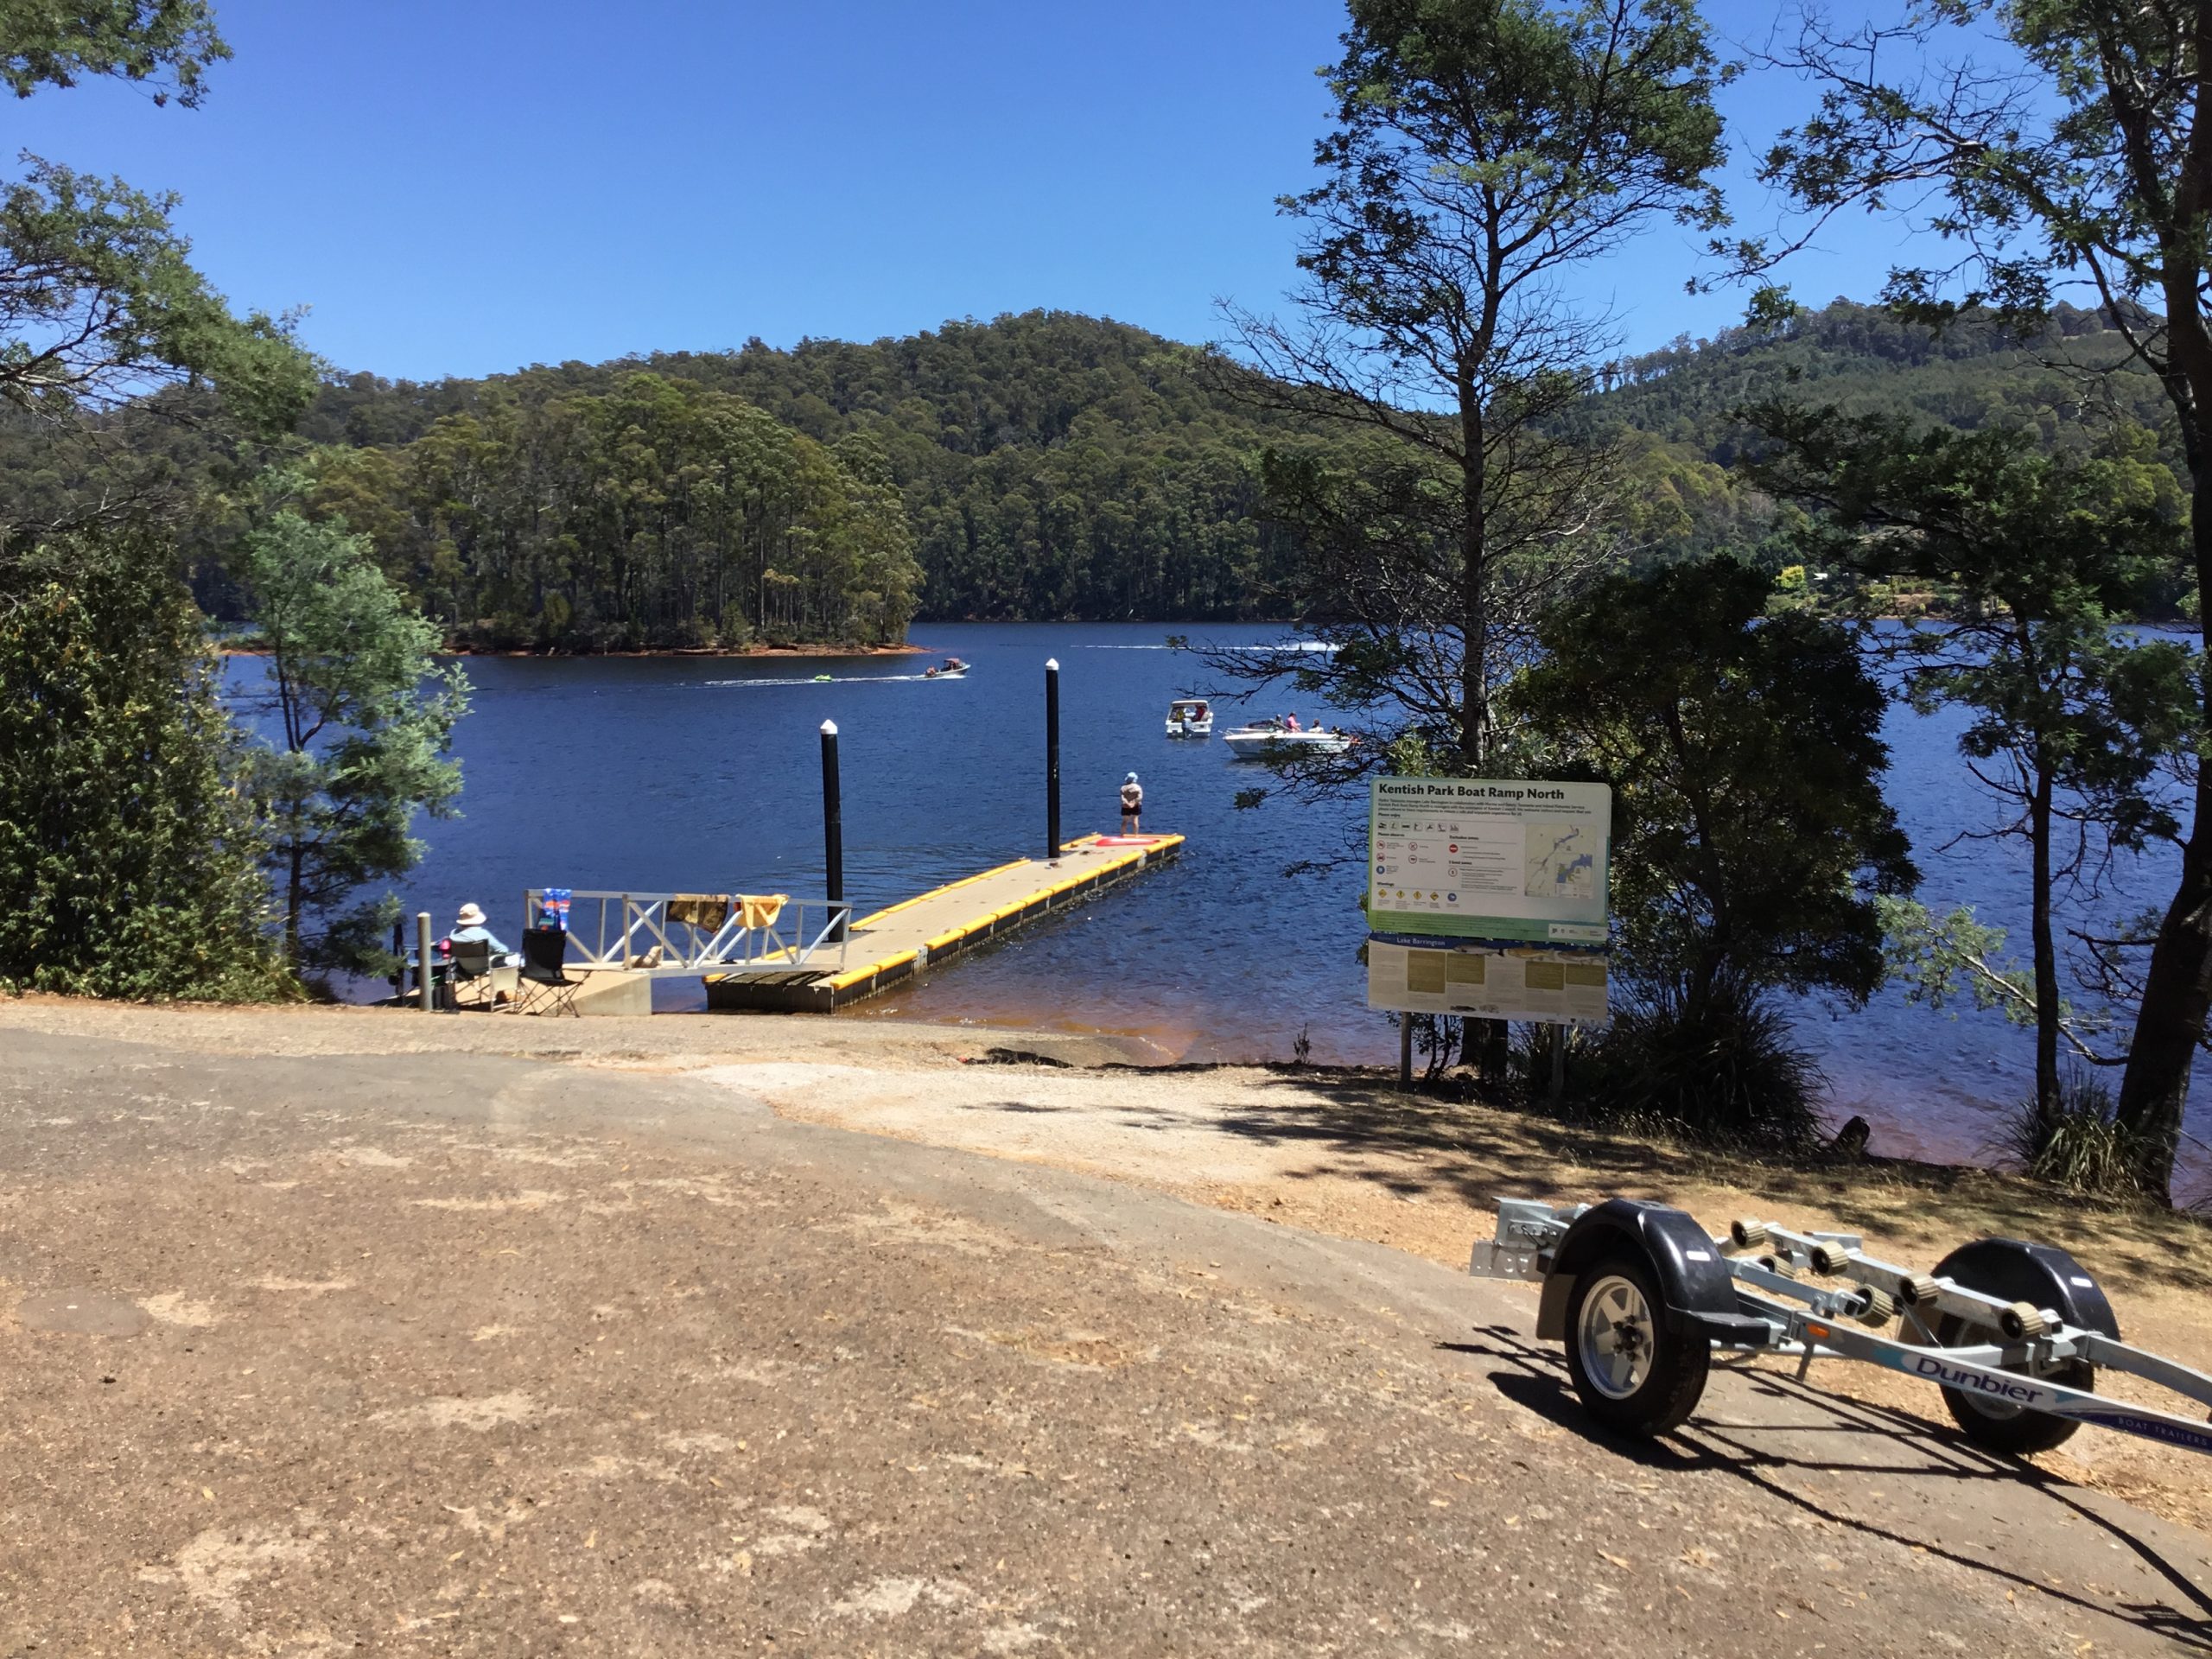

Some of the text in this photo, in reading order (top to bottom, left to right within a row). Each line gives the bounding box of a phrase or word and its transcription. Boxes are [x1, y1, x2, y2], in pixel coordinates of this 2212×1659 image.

[1379, 784, 1565, 800] Kentish Park Boat Ramp North
[1412, 938, 1446, 947] Barrington
[1916, 1357, 2044, 1404] Dunbier
[2119, 1417, 2208, 1446] BOAT TRAILERS
